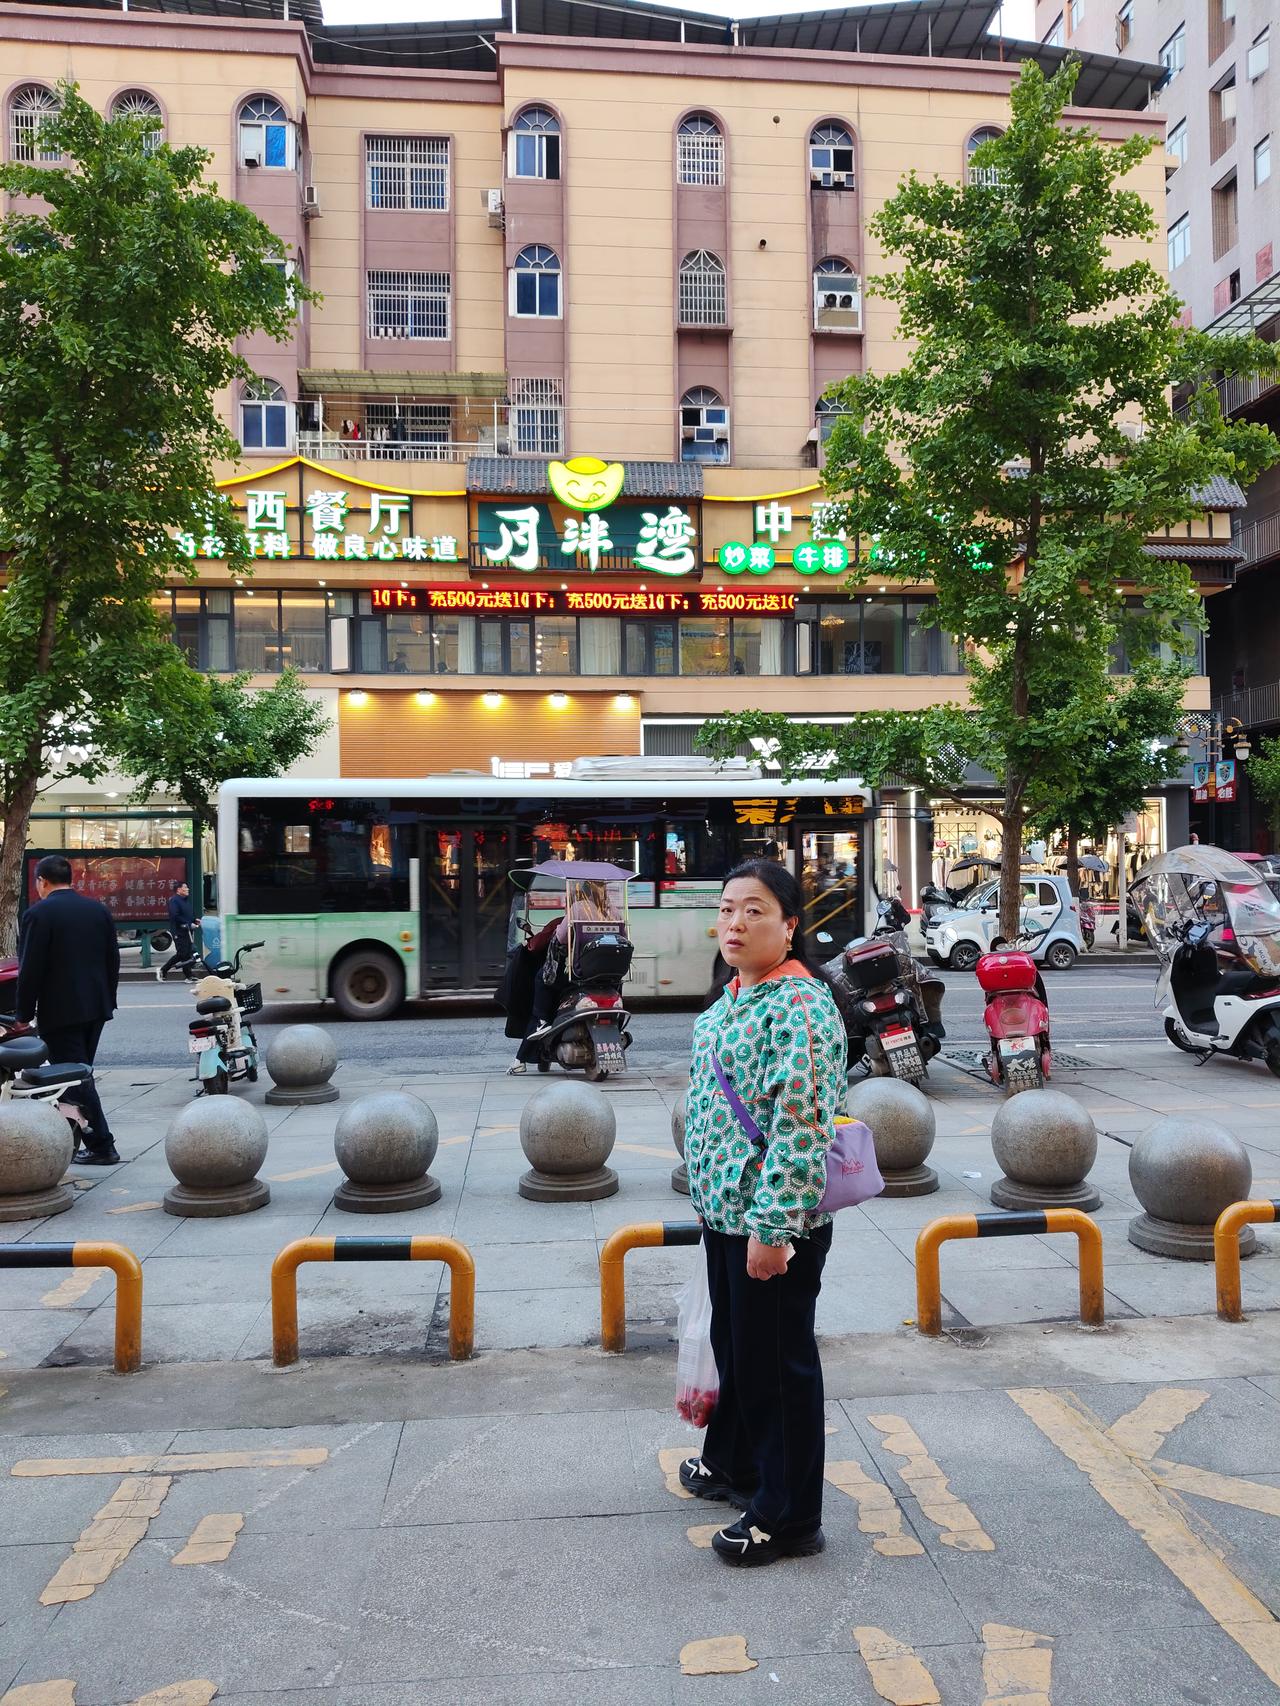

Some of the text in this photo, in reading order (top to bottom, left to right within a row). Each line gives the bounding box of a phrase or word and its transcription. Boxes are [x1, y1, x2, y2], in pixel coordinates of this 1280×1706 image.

[191, 490, 411, 534] 西餐厅
[313, 535, 459, 562] 做良心味道
[722, 544, 773, 569] 炒菜
[797, 545, 845, 569] 牛排
[126, 895, 171, 907] 香飘海内
